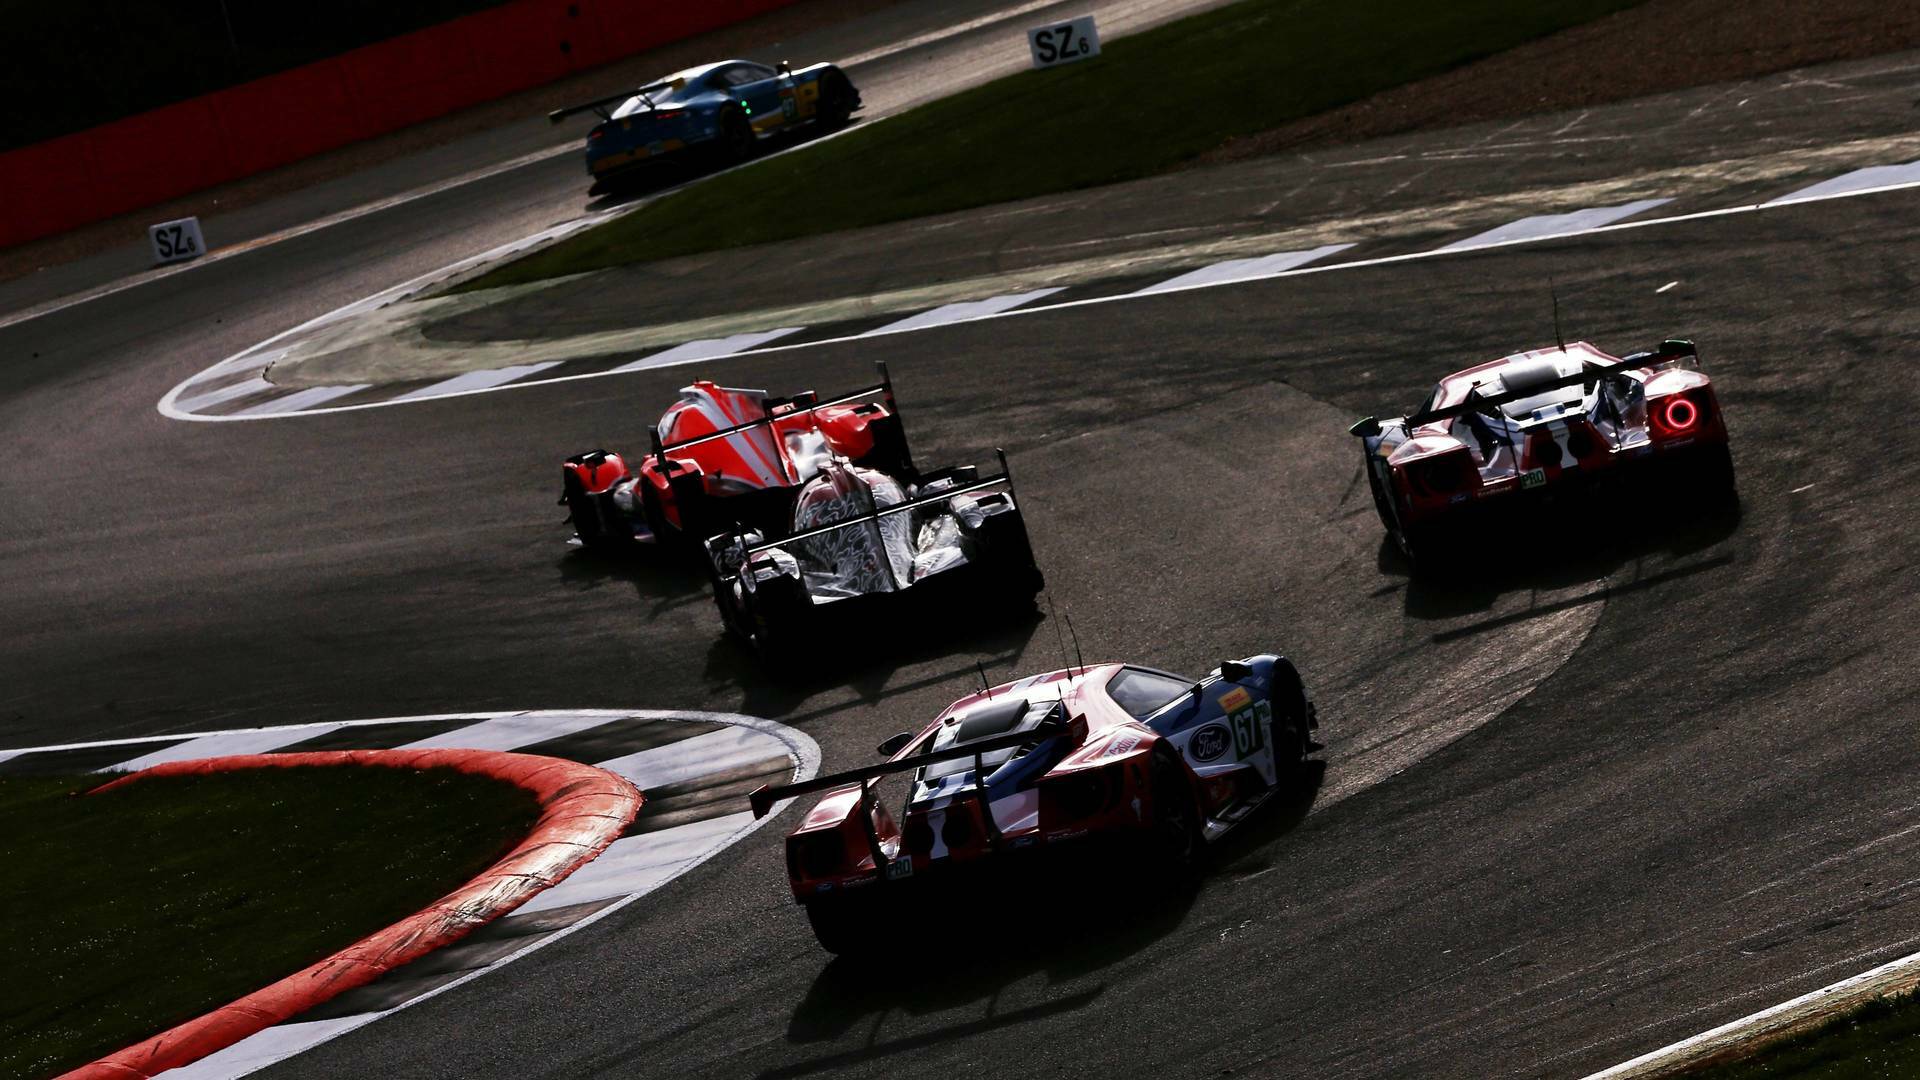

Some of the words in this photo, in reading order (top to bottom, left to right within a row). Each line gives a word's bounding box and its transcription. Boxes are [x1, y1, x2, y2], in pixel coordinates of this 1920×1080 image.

[1521, 470, 1545, 487] PRO
[1234, 707, 1256, 753] 67
[1197, 730, 1226, 757] Ford
[887, 859, 911, 877] PRO
